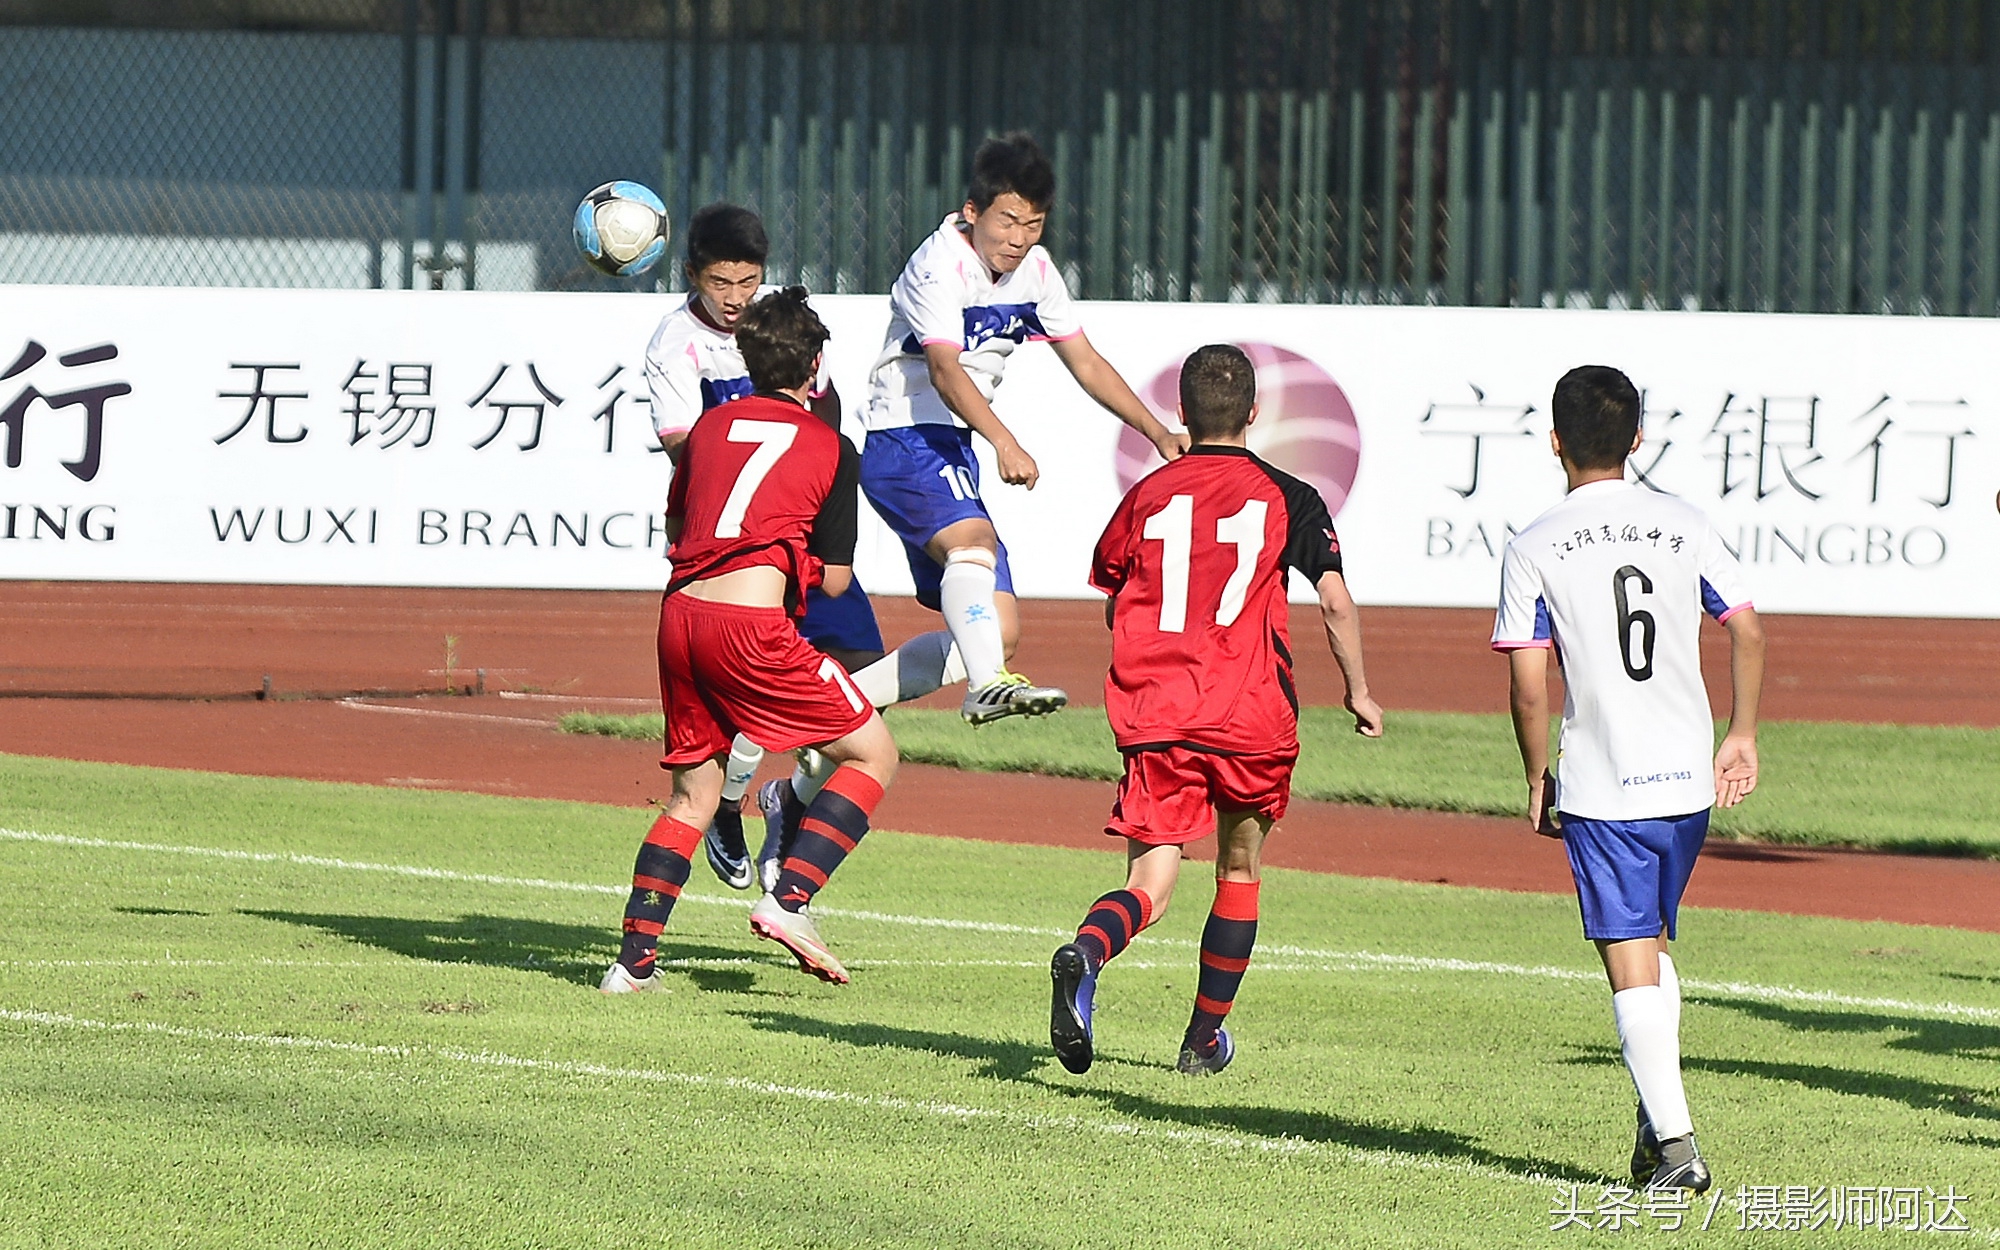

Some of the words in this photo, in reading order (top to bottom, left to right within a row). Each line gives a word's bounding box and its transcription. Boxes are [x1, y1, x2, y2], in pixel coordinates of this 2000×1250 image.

[0, 338, 132, 482] 行
[209, 505, 378, 544] WUXI
[714, 418, 799, 538] 7
[938, 464, 979, 501] 10
[1143, 494, 1269, 633] 11
[1613, 564, 1656, 682] 6
